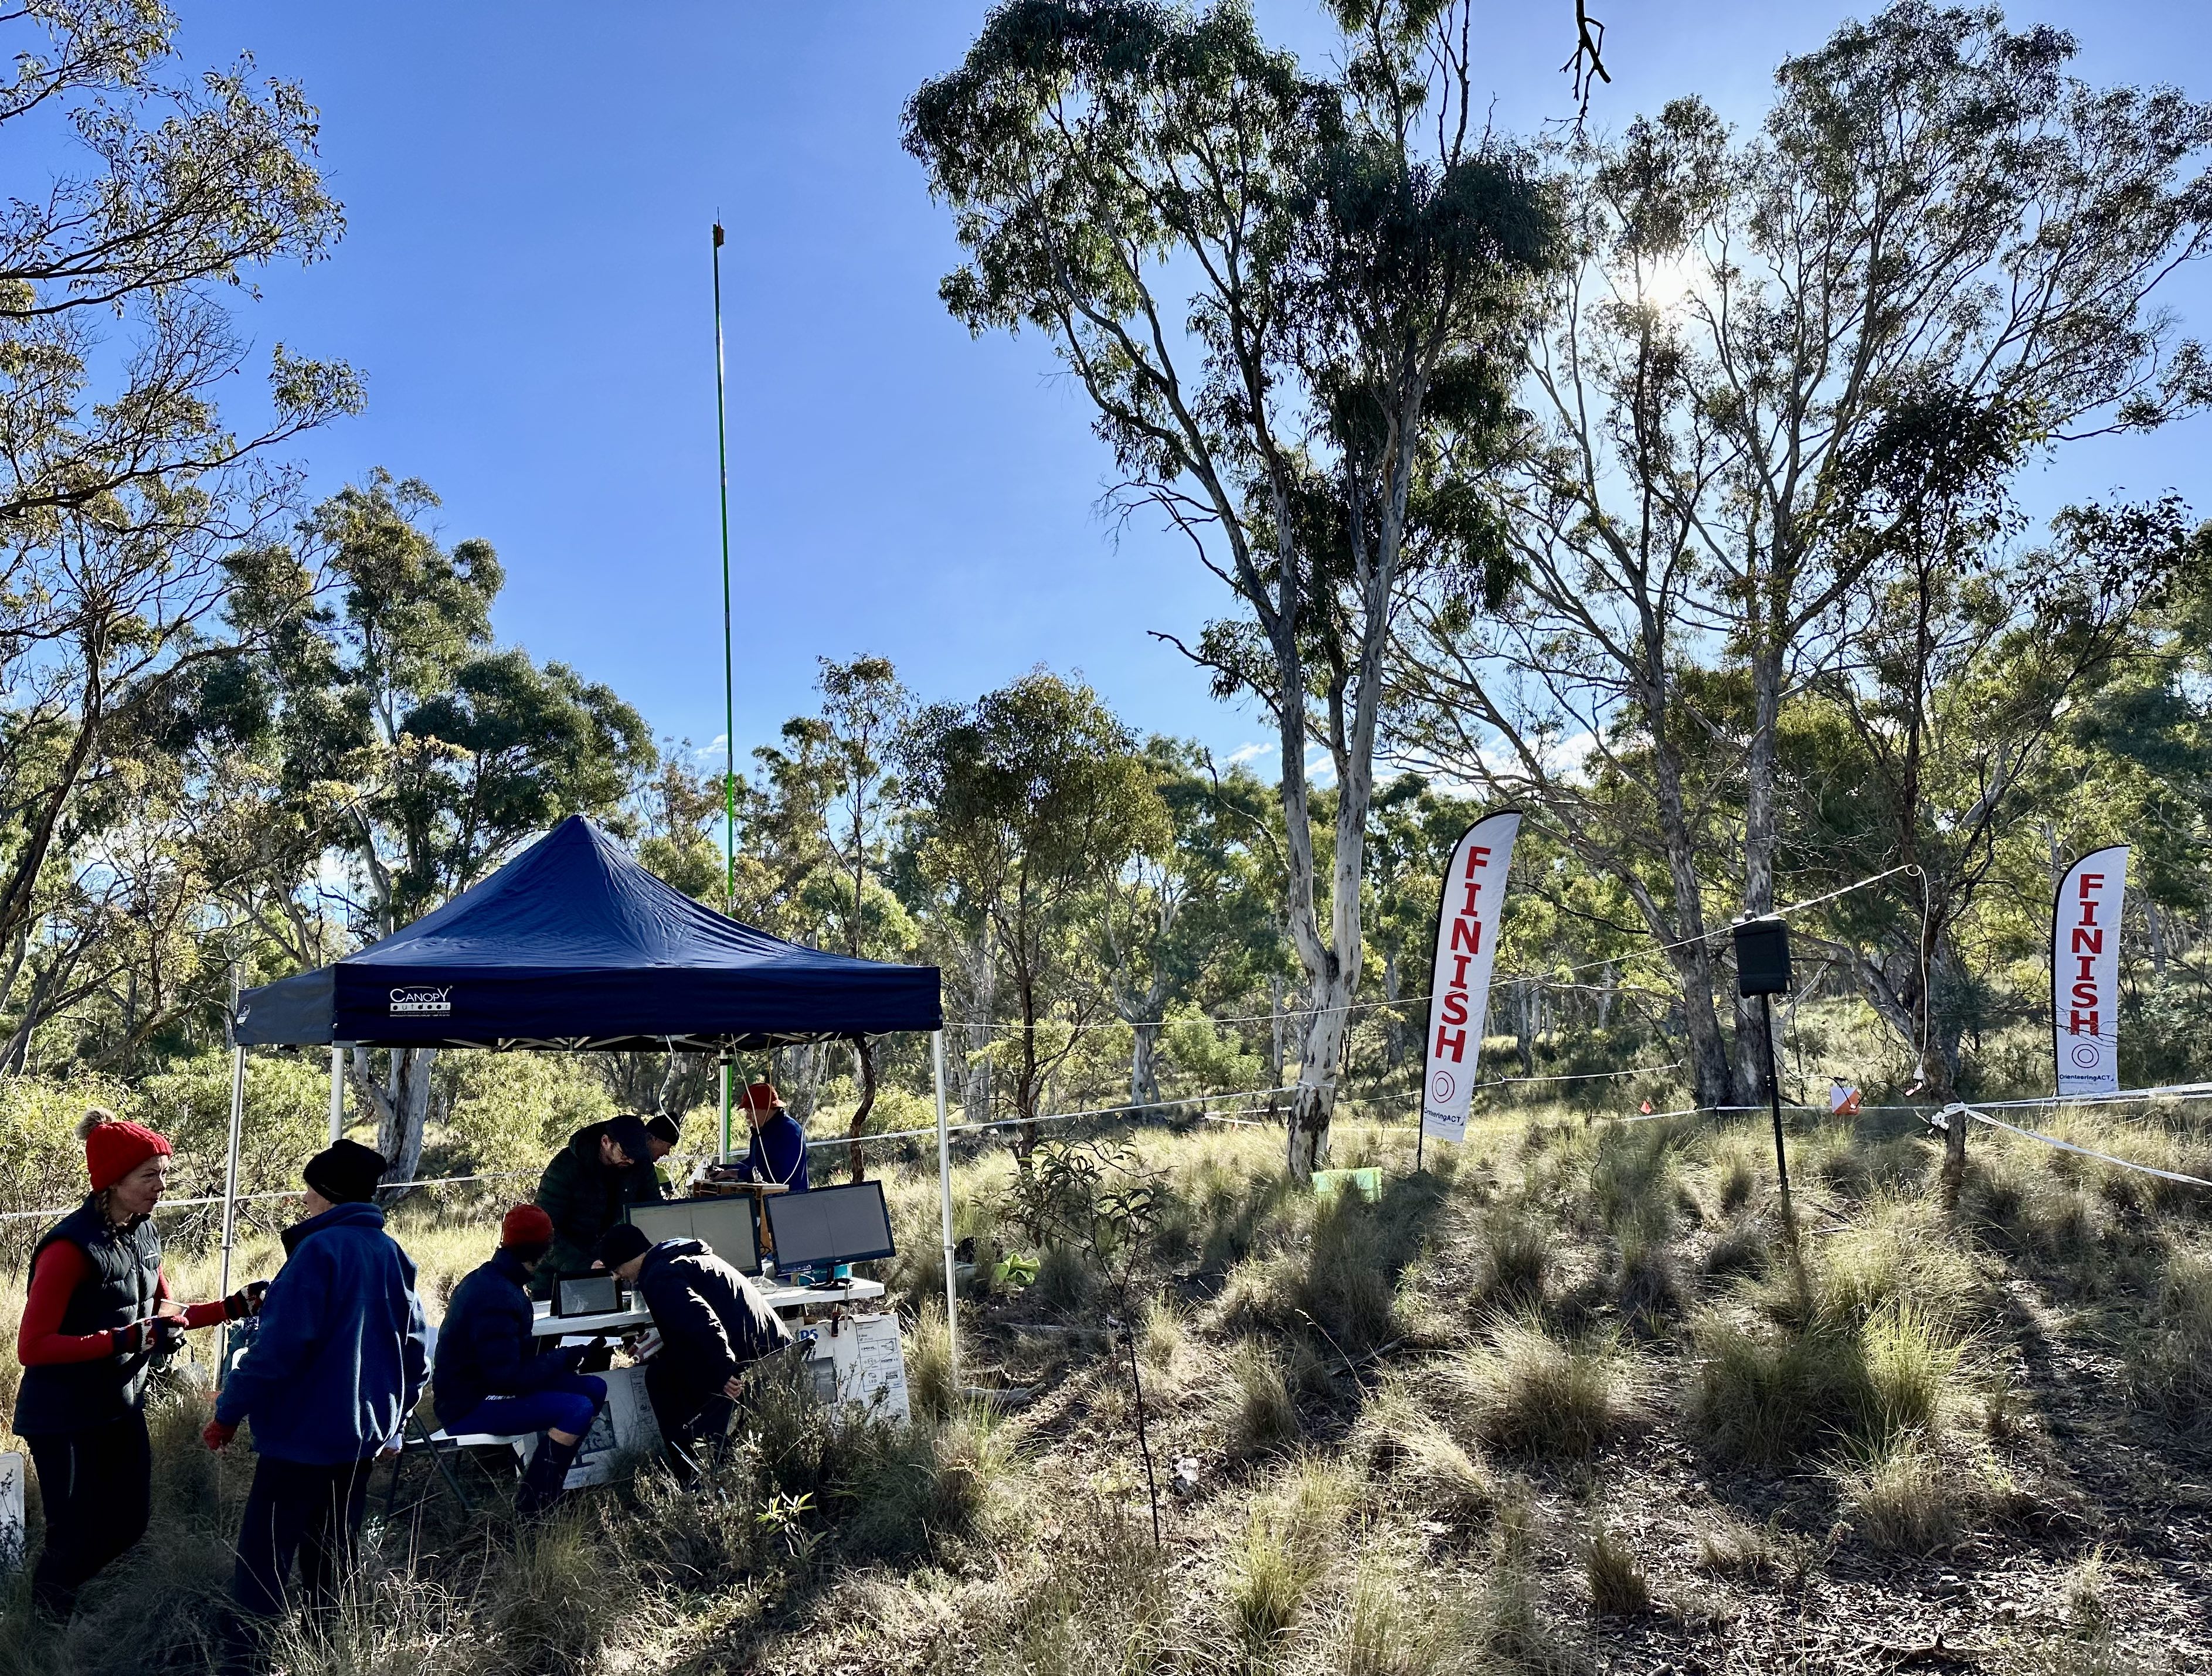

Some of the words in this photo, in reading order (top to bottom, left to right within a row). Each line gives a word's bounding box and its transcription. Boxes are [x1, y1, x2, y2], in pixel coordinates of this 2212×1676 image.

[390, 988, 450, 1002] CANOPY
[1435, 845, 1491, 1063] FINISH
[2070, 873, 2105, 1036] FINISH
